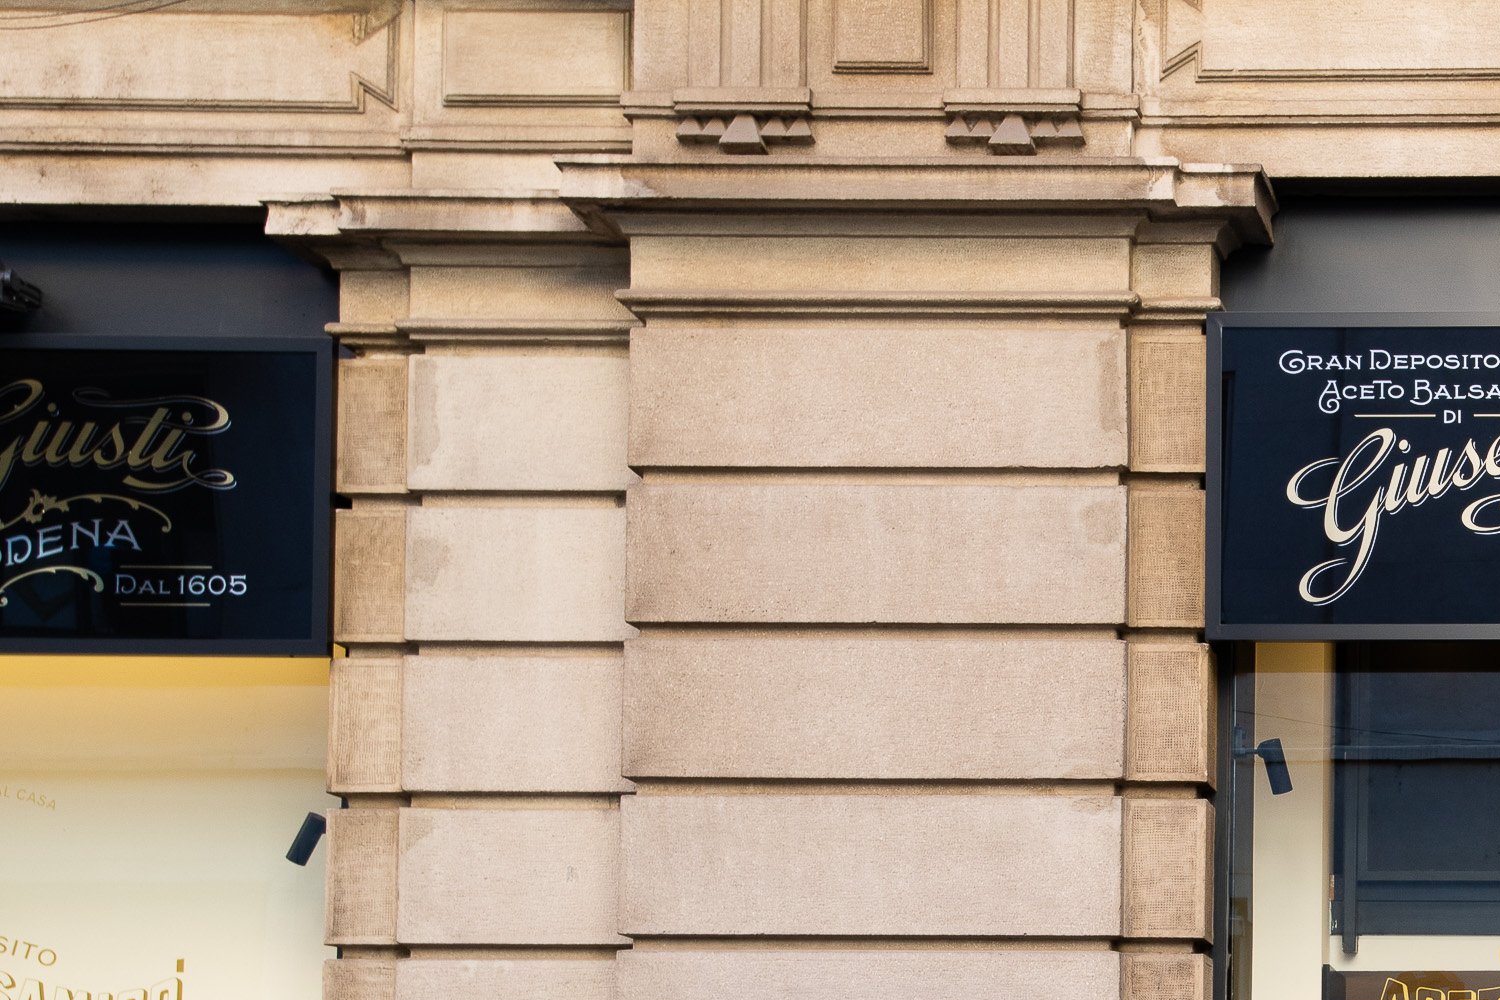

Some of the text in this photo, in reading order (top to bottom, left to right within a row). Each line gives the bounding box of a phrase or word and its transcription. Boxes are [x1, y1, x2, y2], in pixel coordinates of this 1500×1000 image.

[1279, 349, 1500, 374] GRAN DEPOSITO
[1318, 379, 1405, 414] ACETO
[1443, 409, 1462, 424] DI
[177, 573, 248, 596] 1605
[16, 788, 56, 811] CASA
